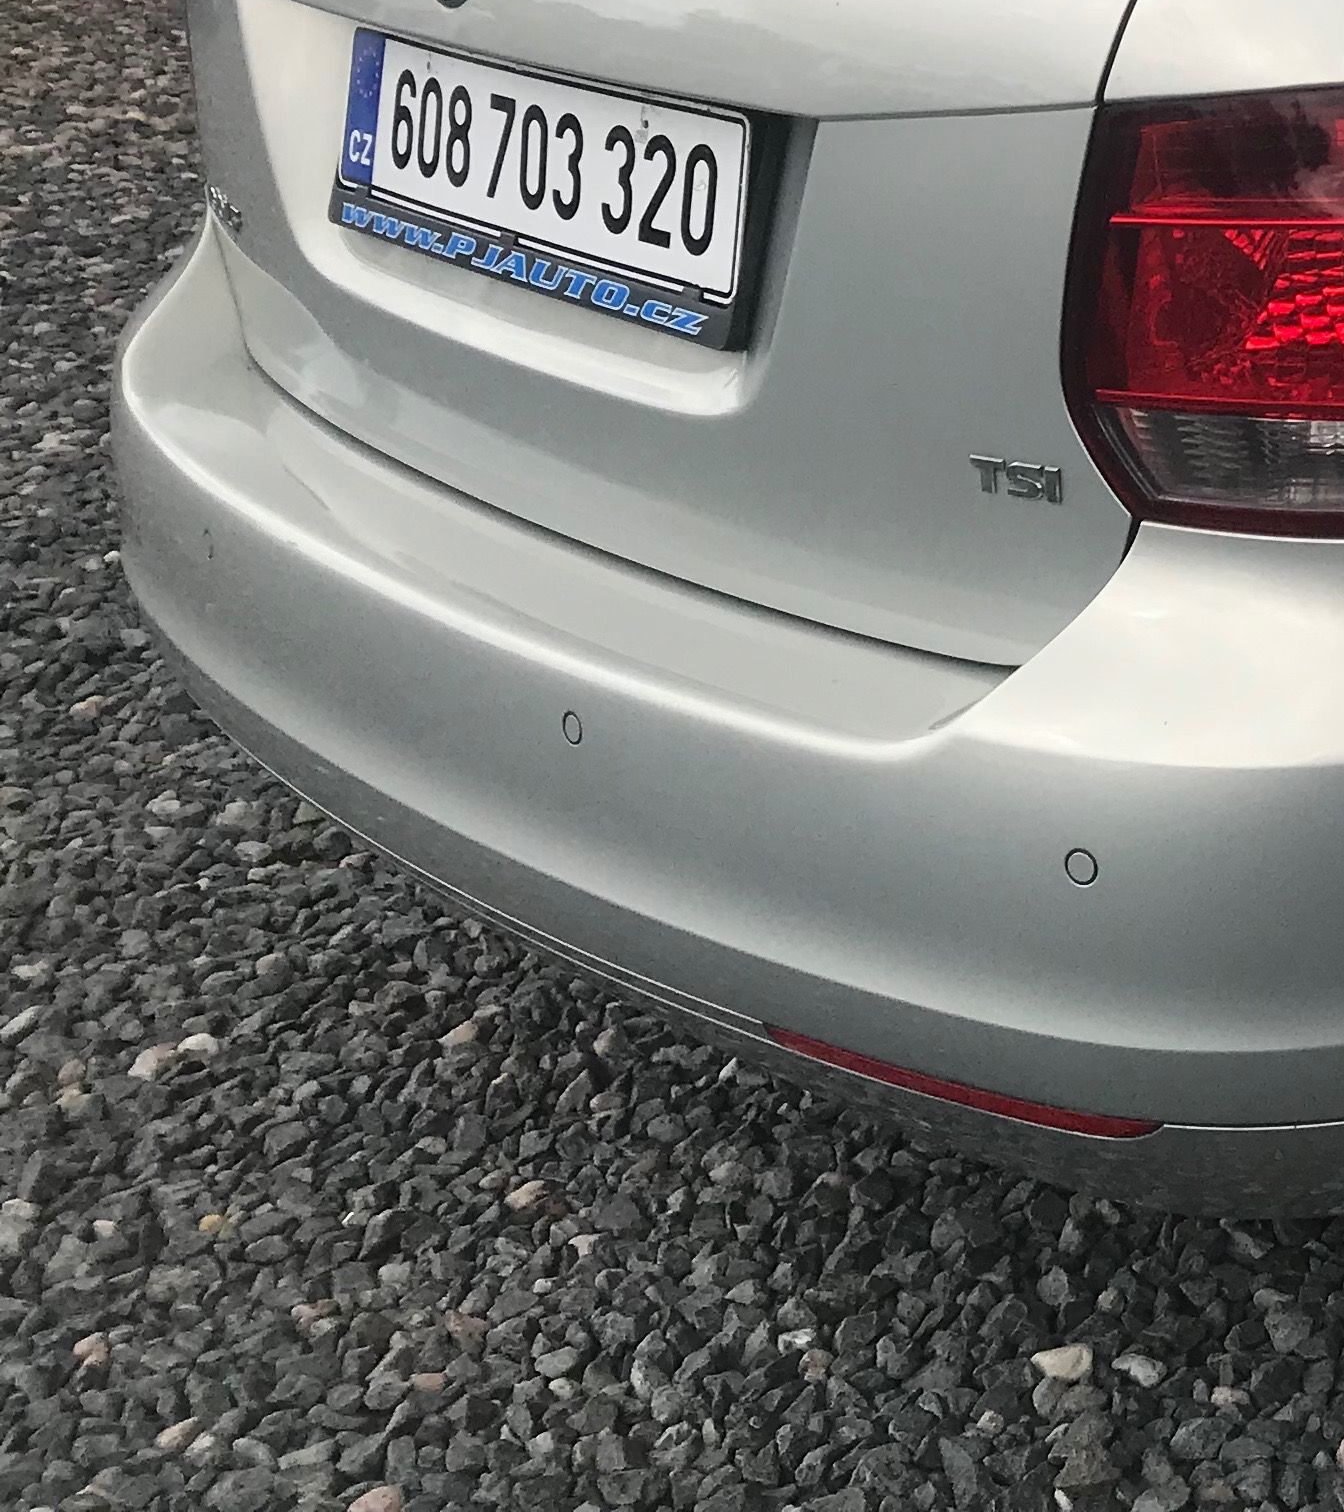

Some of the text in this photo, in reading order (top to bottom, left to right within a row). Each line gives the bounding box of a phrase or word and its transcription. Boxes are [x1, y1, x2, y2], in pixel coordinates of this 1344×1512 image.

[349, 129, 373, 166] CZ
[391, 68, 718, 257] 608 703 320
[968, 453, 1063, 505] TSI
